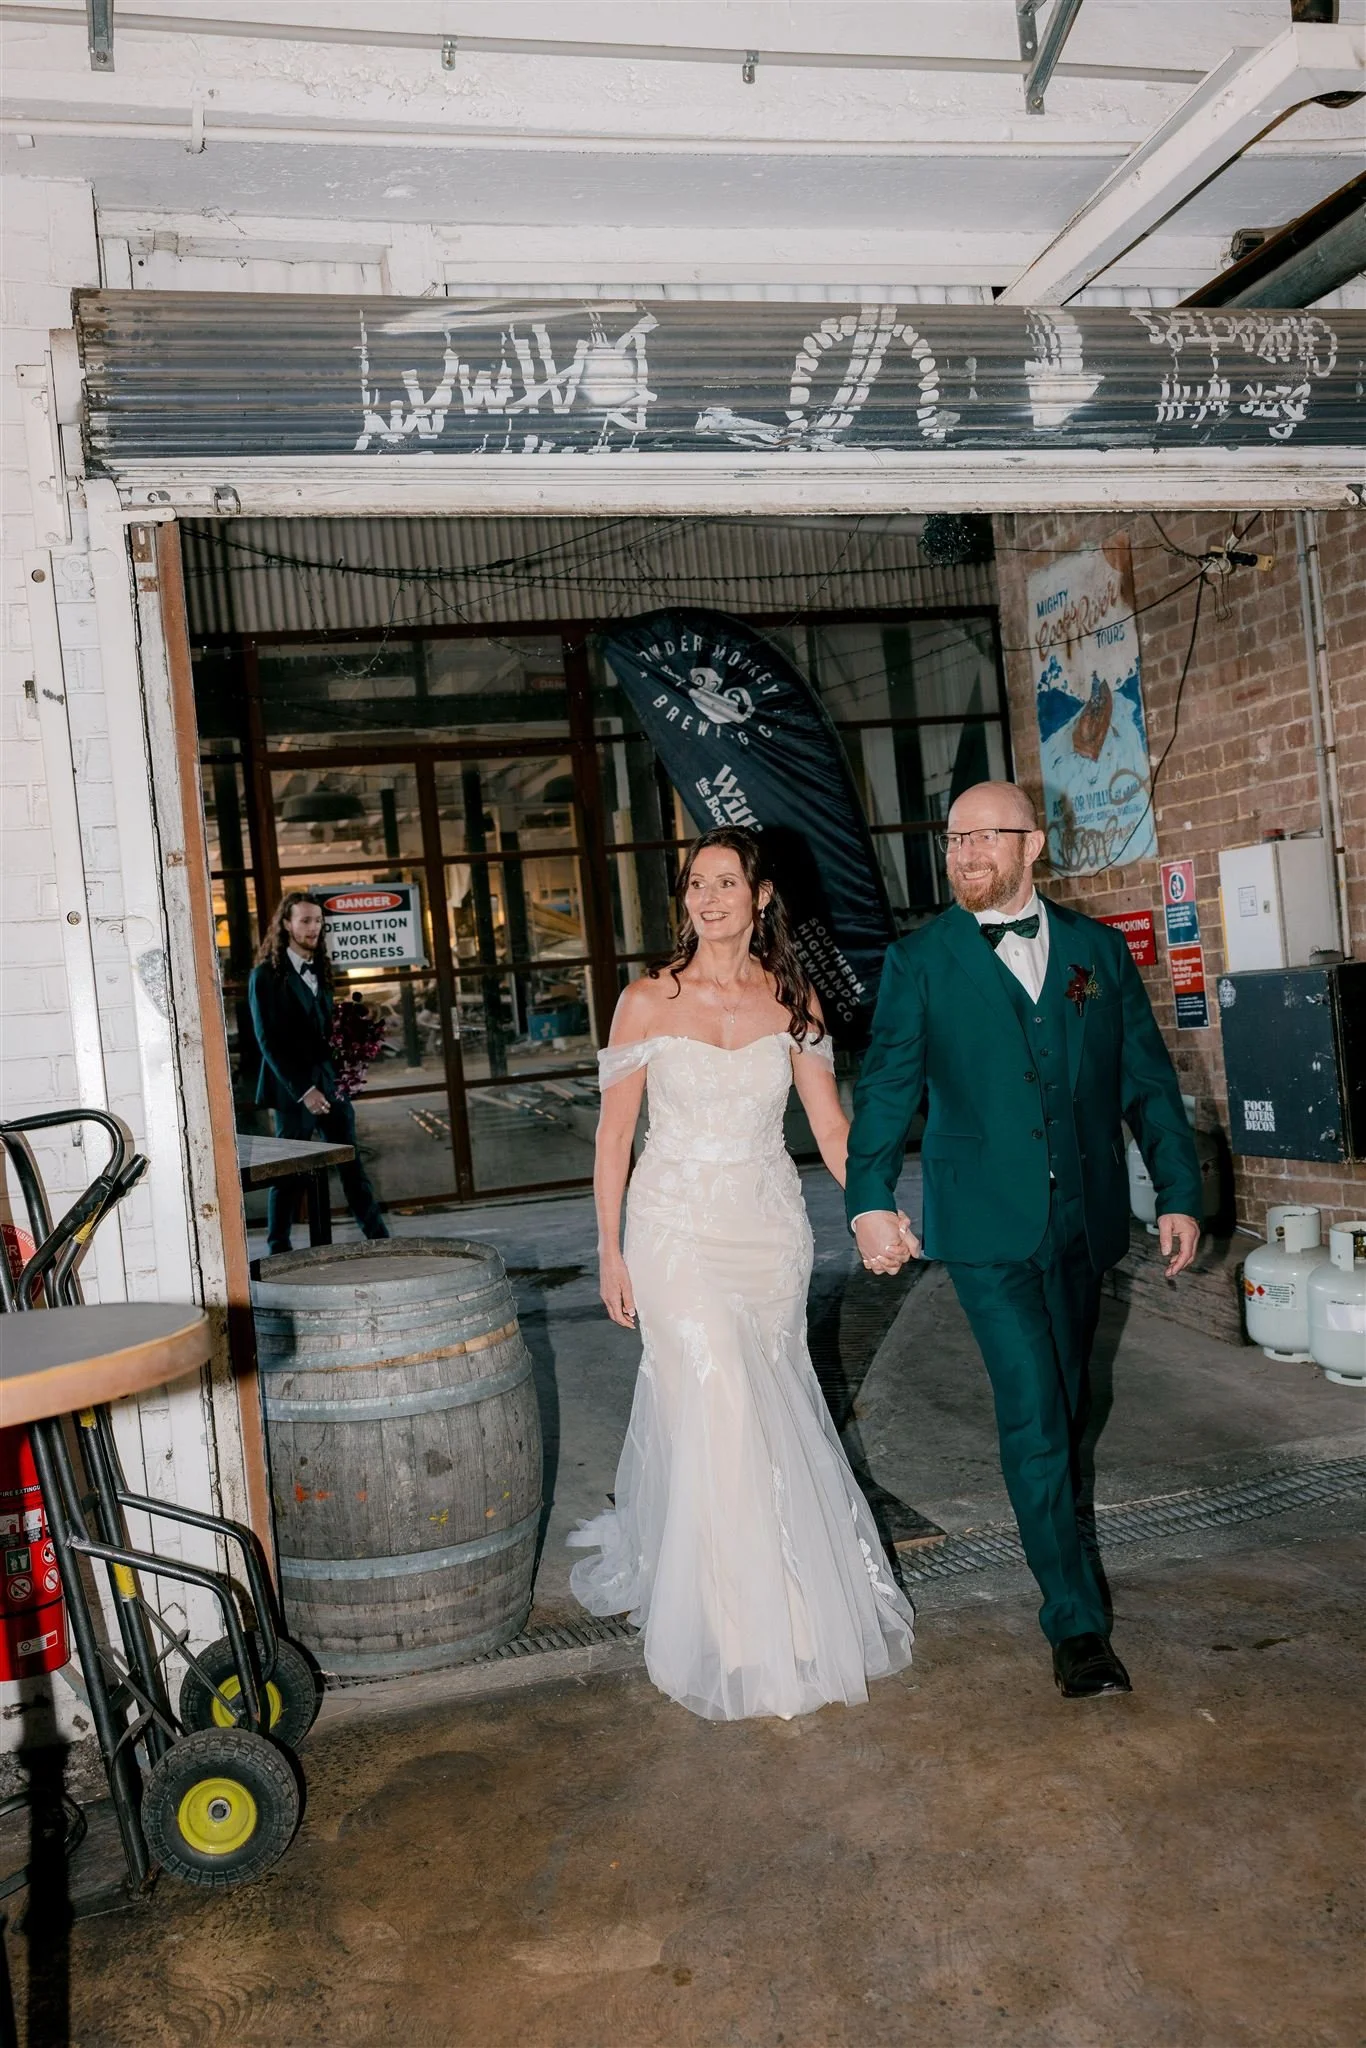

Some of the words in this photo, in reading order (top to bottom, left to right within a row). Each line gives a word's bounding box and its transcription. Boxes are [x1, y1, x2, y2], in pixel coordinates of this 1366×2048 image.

[1036, 588, 1069, 618] MIGHTY
[1095, 624, 1126, 648] TOURS
[712, 644, 780, 696] MONKEY
[652, 694, 749, 746] BREWIG
[697, 776, 712, 796] the
[704, 795, 731, 826] Boa
[335, 896, 391, 909] DANGER
[324, 917, 408, 933] DEMOLITION
[337, 934, 377, 946] WORK
[382, 933, 396, 943] IN
[1140, 940, 1150, 948] OF
[332, 946, 405, 961] PROGRESS
[809, 917, 866, 995] SOUTHERN
[798, 923, 861, 1006] HIGHLANDS
[792, 930, 836, 999] REWING
[836, 1001, 854, 1022] CO
[1244, 1111, 1275, 1121] COVERS
[1245, 1120, 1276, 1132] DECON
[15, 1485, 41, 1496] EXTINGU
